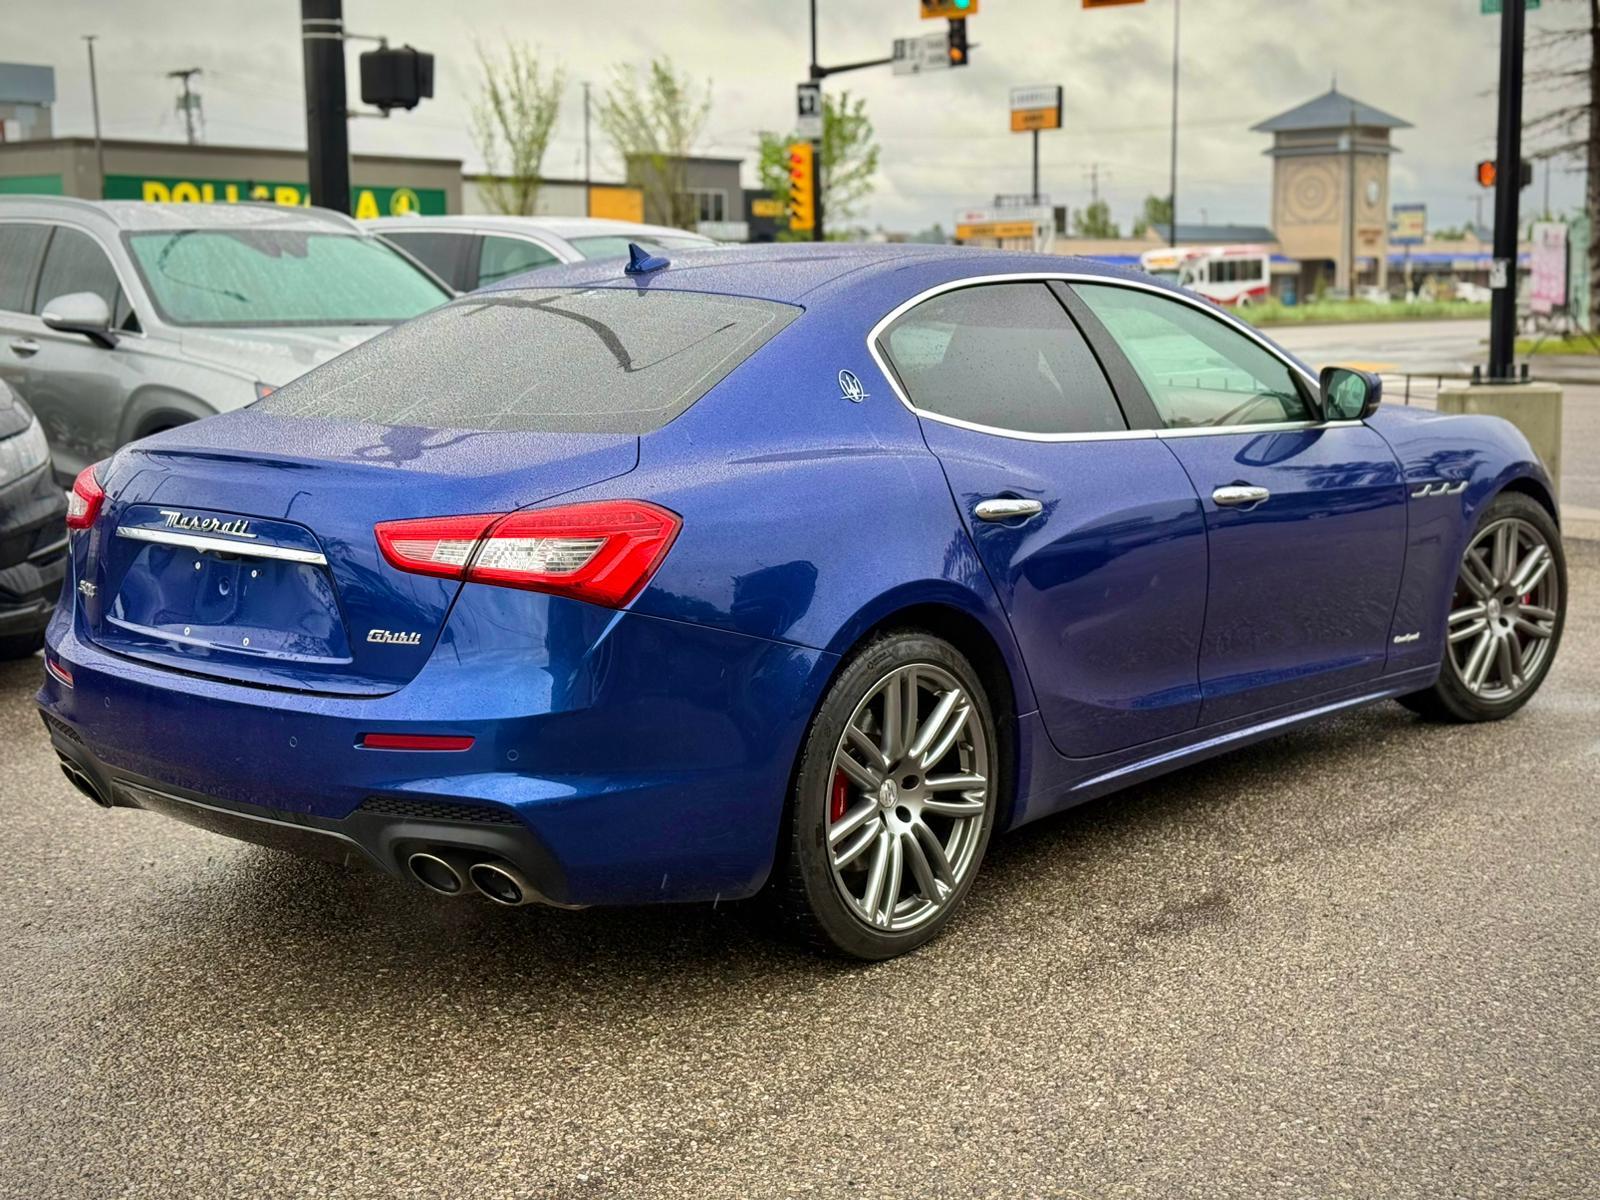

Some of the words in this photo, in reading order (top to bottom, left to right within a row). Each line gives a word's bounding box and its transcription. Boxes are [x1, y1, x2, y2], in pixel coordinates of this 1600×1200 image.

[142, 181, 379, 219] DOLLRA
[160, 510, 257, 538] Maserati
[367, 629, 421, 645] Ghibli
